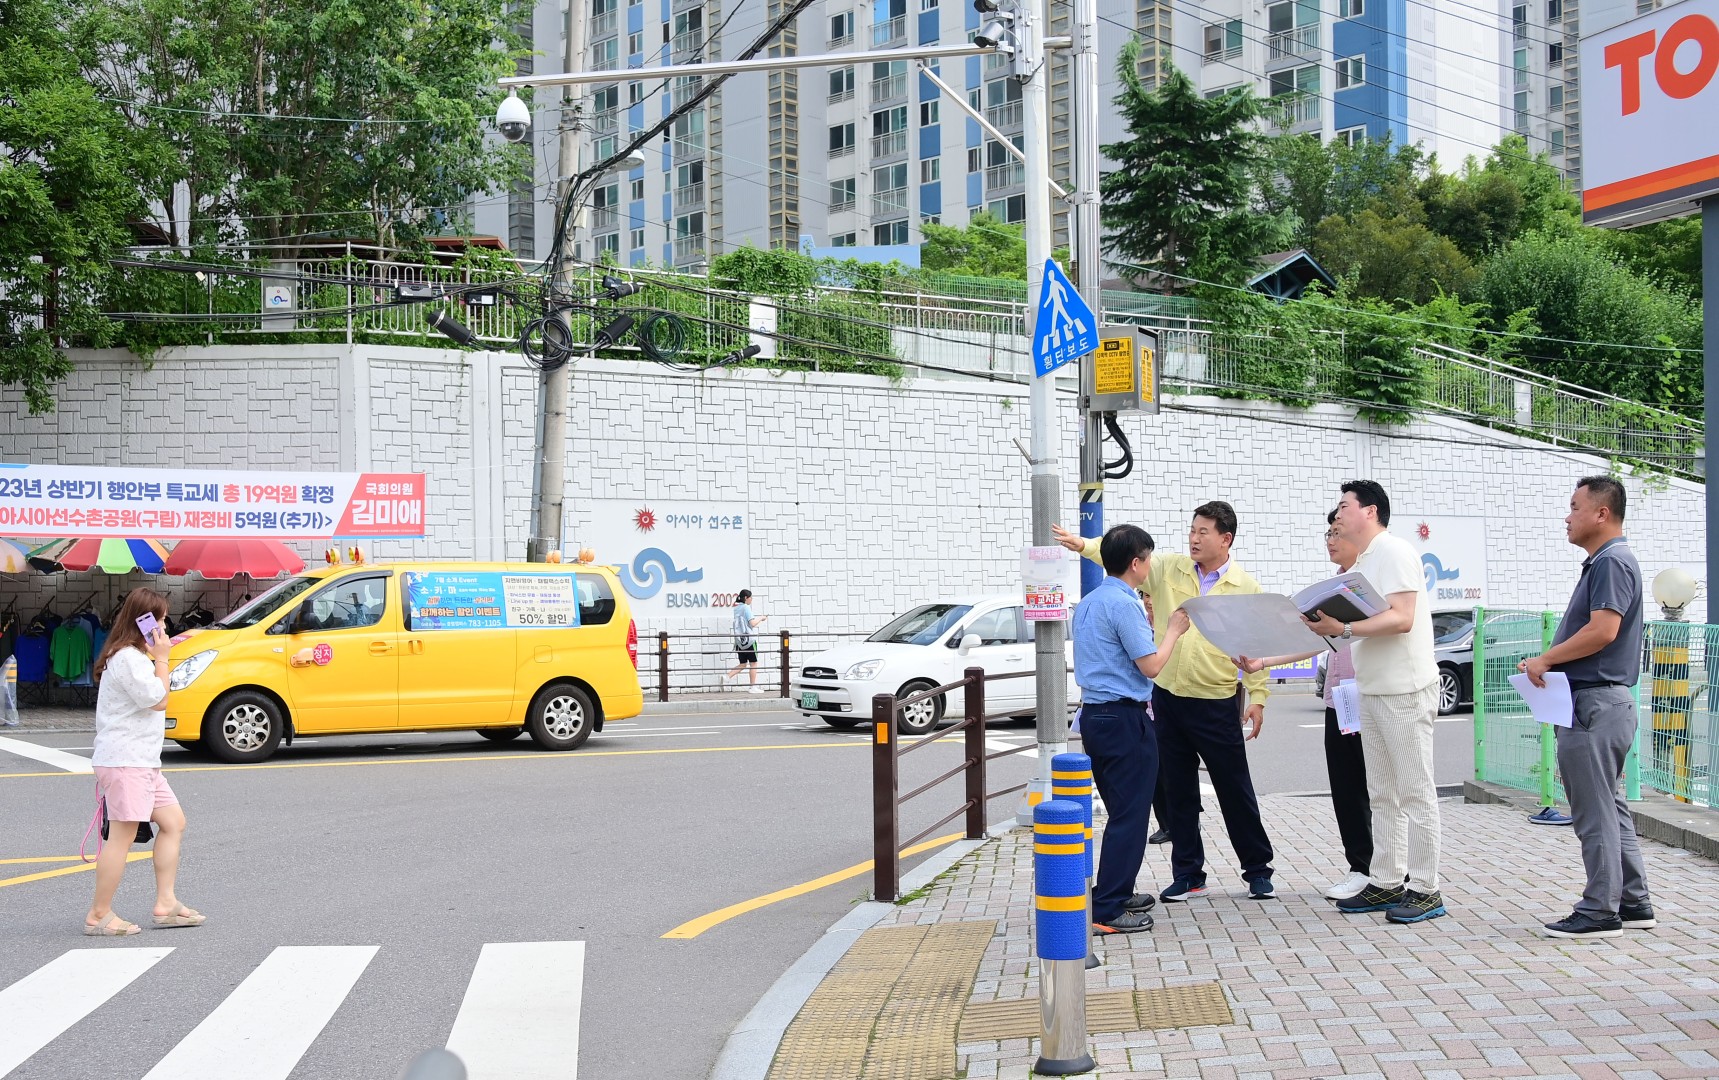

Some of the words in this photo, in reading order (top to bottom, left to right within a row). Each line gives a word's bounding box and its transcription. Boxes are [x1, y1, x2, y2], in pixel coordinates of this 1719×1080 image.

[1604, 13, 1719, 117] TO
[1043, 337, 1090, 370] 횡단보도
[0, 478, 42, 498] 23년
[47, 479, 102, 500] 상반기
[107, 481, 162, 501] 행안부
[166, 482, 219, 502] 특교세
[223, 484, 240, 503] 총
[244, 485, 297, 504] 19억원
[302, 485, 334, 504] 확정
[366, 482, 413, 496] 국회의원
[0, 507, 181, 529] 아시아선수촌공원(구립)
[184, 510, 232, 529] 재정비
[352, 500, 421, 525] 김미애
[666, 514, 702, 528] 아시아
[708, 515, 743, 530] 선수촌
[666, 593, 708, 608] BUSAN
[712, 593, 738, 608] 2002
[1038, 594, 1062, 604] 교차로
[1437, 588, 1463, 600] BUSAN
[1464, 588, 1481, 599] 2002
[420, 608, 454, 618] 함께하는
[456, 608, 474, 617] 할인
[476, 607, 501, 617] 이벤트
[520, 614, 544, 624] 50%
[547, 614, 567, 624] 할인
[314, 648, 332, 659] 정지
[802, 697, 816, 707] 7939
